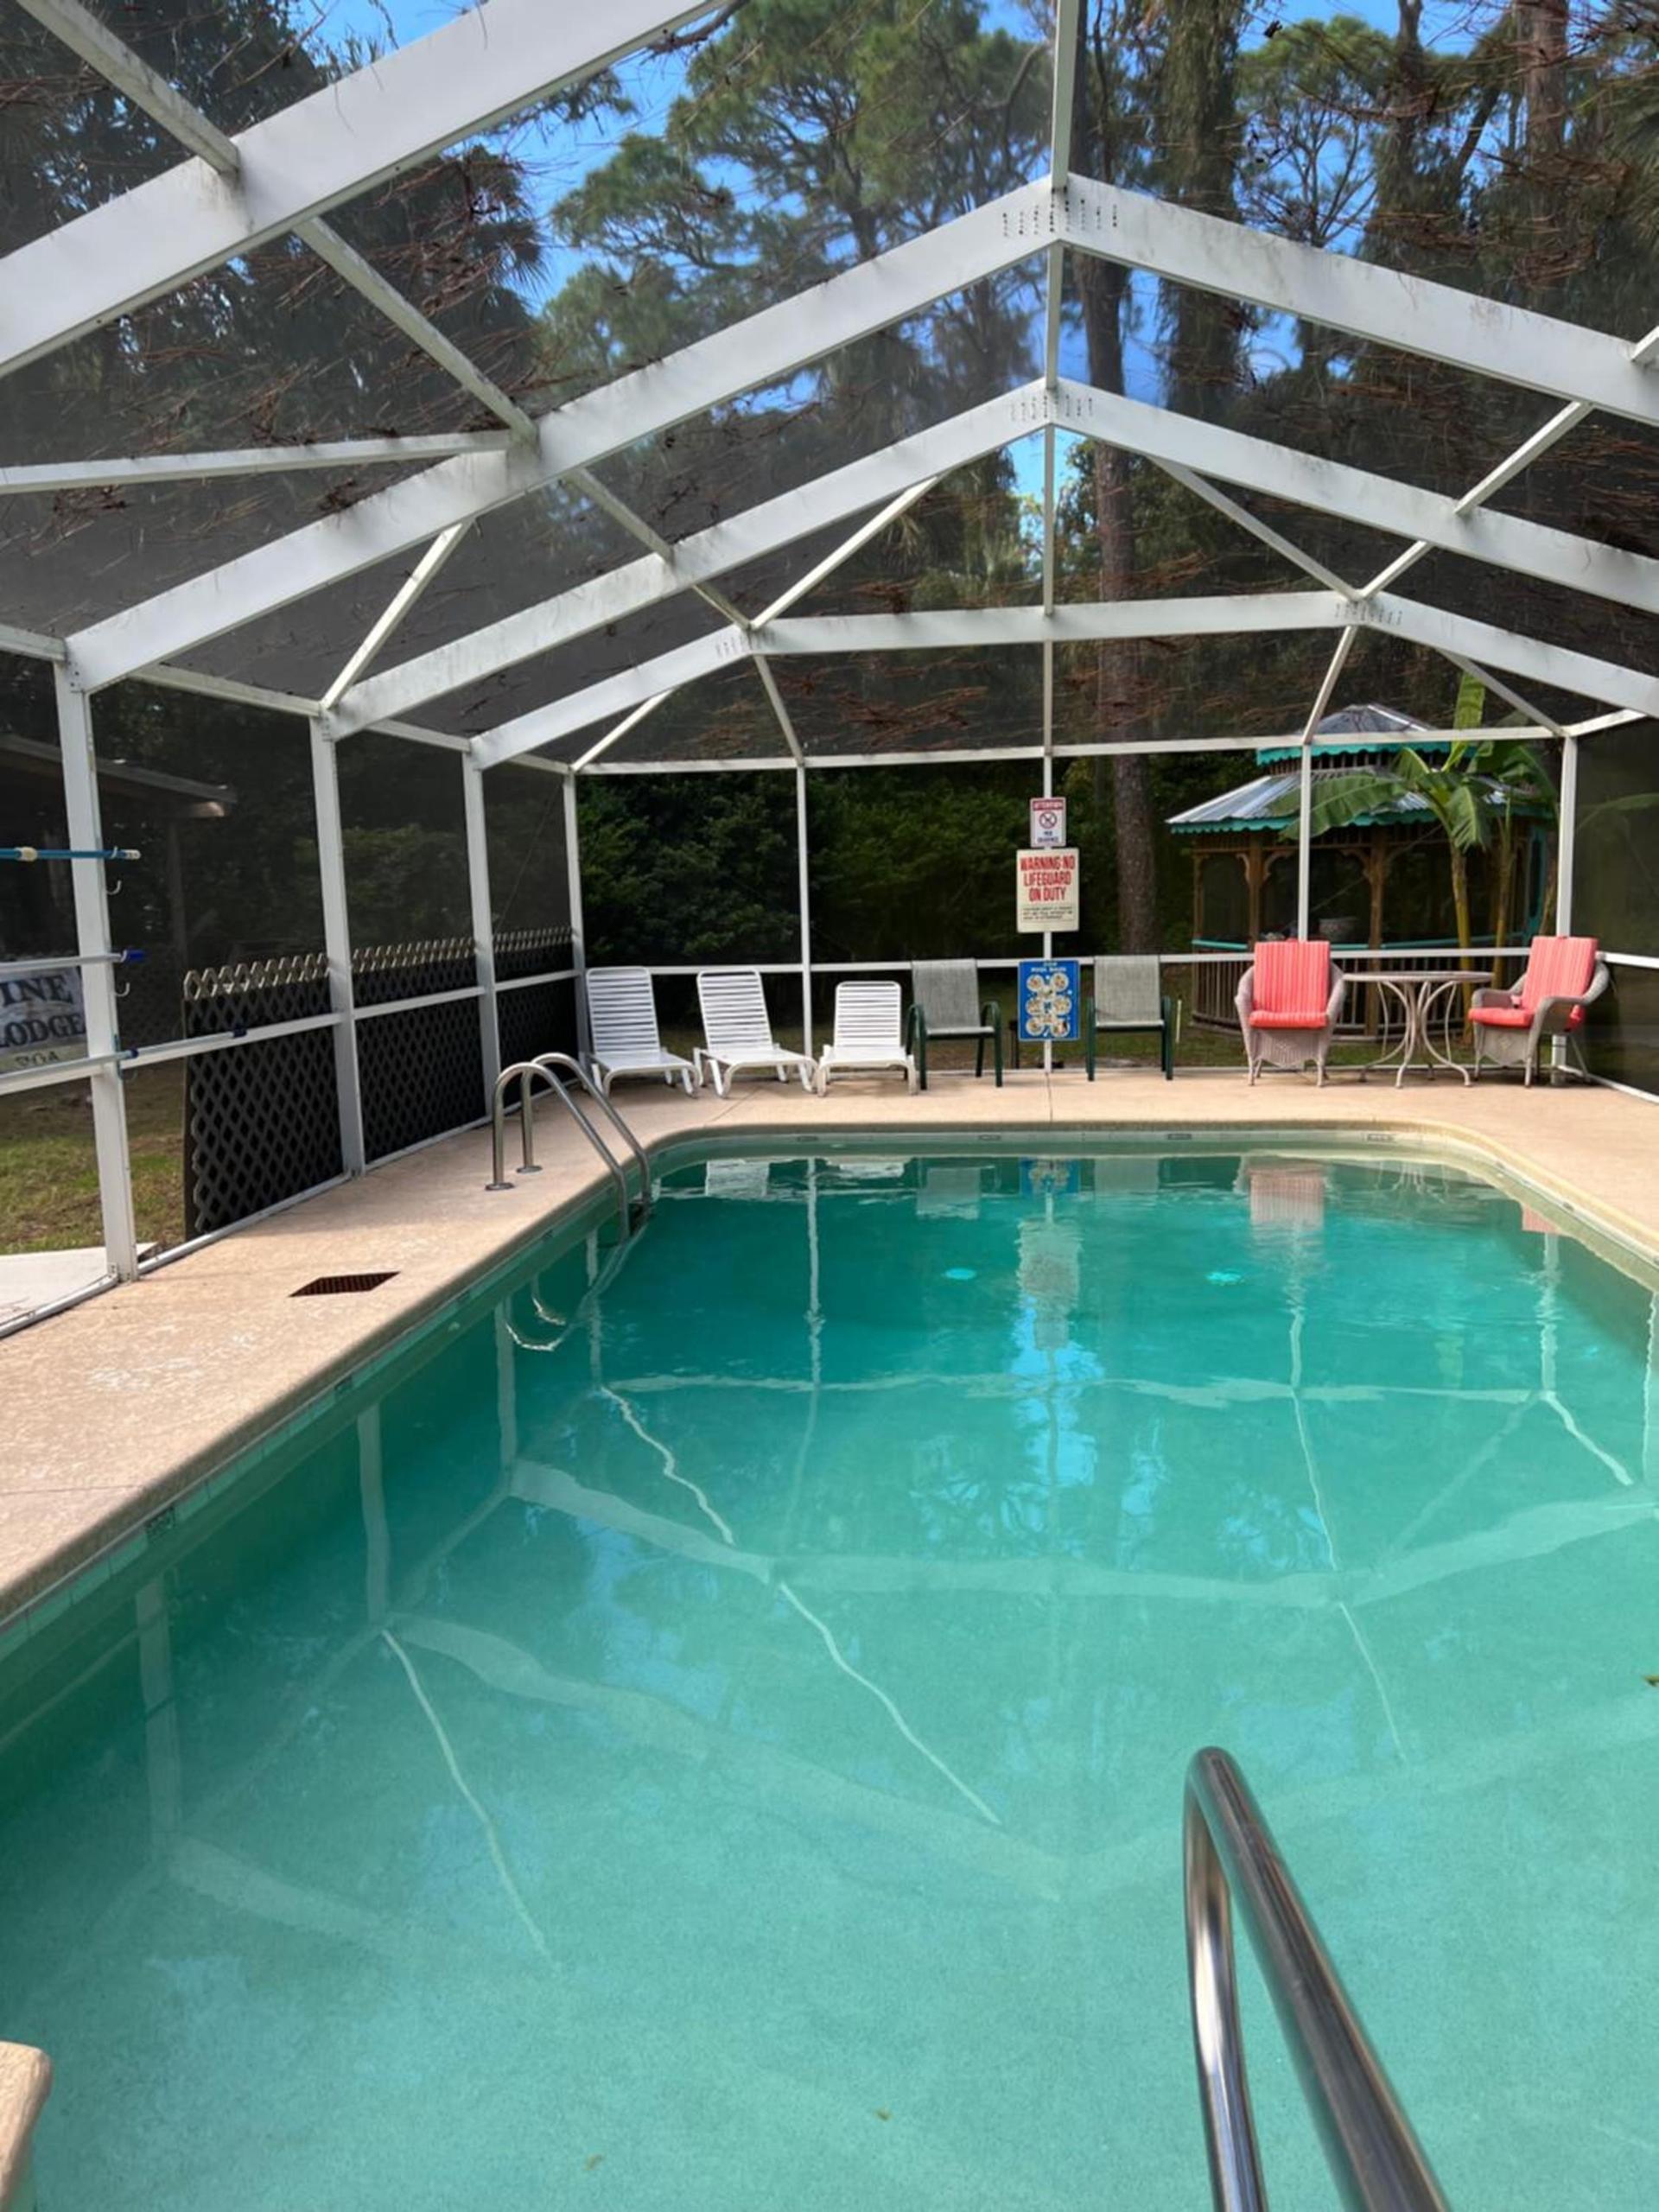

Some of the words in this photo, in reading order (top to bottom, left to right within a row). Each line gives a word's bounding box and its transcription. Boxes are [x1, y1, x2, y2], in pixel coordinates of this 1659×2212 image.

[1023, 871, 1071, 887] LIFEGUARD
[1029, 887, 1041, 901] ON
[1043, 887, 1066, 901] DUTY
